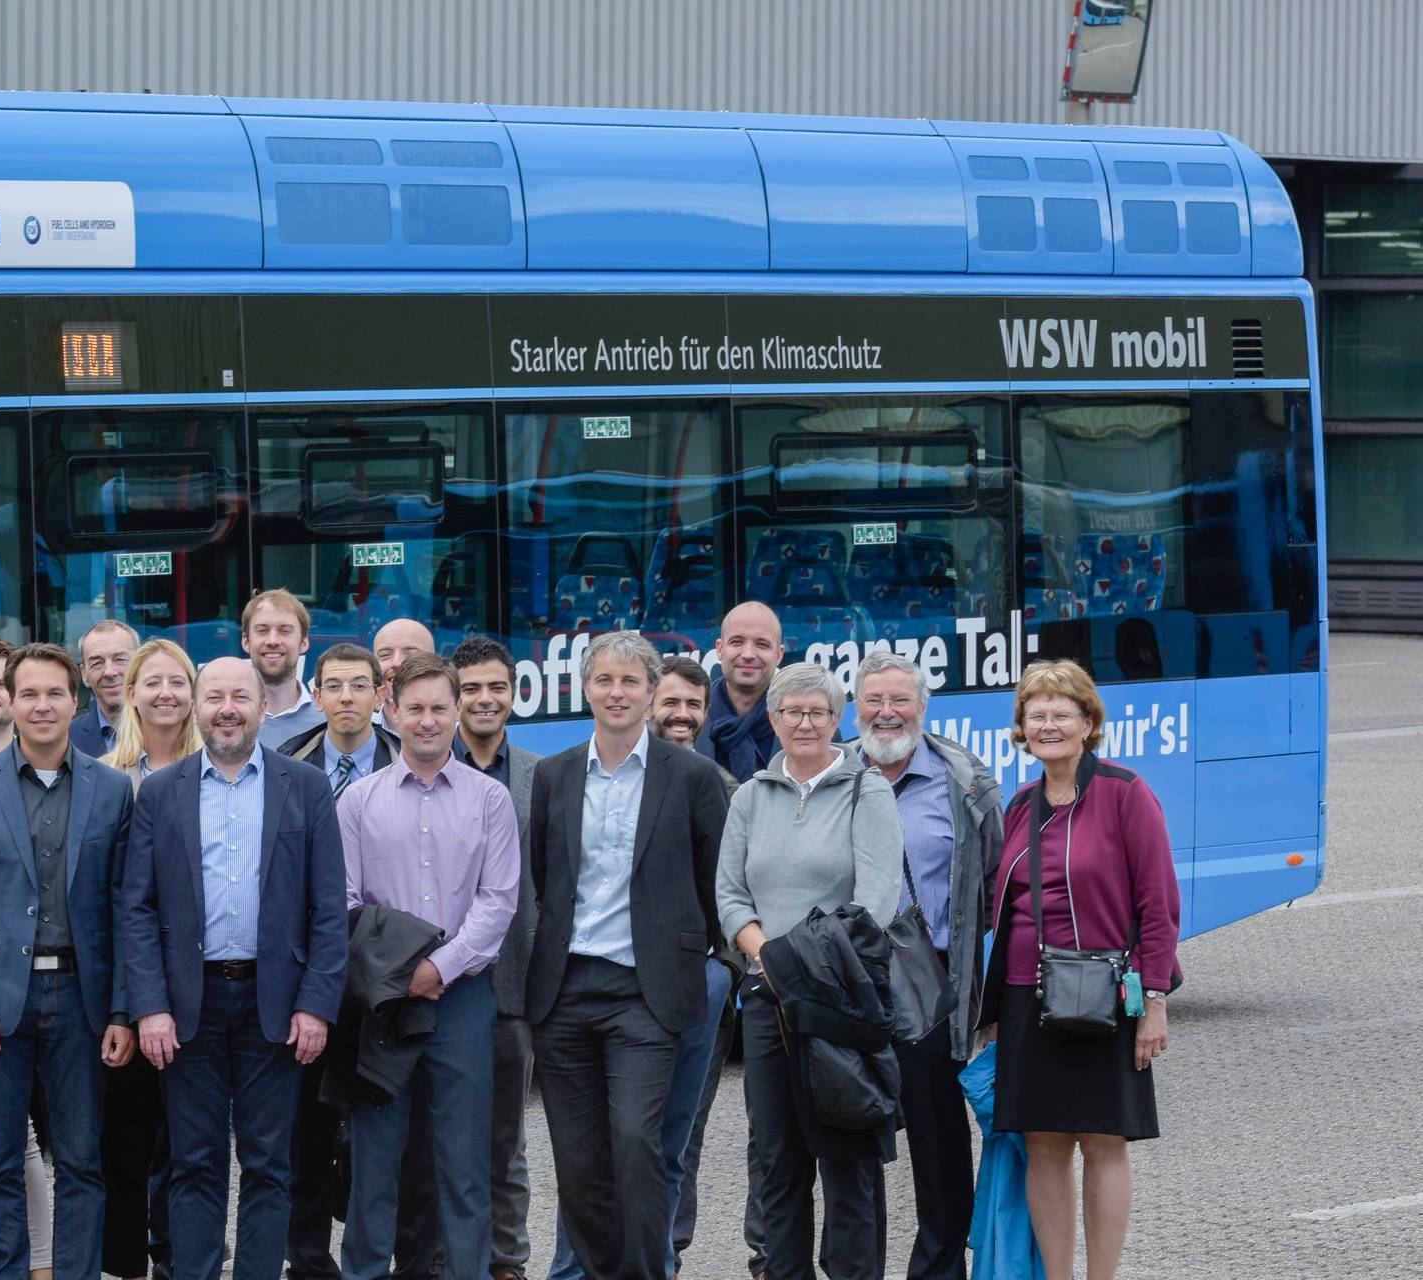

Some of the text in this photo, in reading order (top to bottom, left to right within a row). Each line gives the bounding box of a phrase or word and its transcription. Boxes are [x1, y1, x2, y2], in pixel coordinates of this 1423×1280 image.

[510, 334, 883, 373] Starker Antrieb für den Klimaschutz
[998, 316, 1207, 369] WSW mobil
[930, 702, 1188, 785] Wupp wir's!
